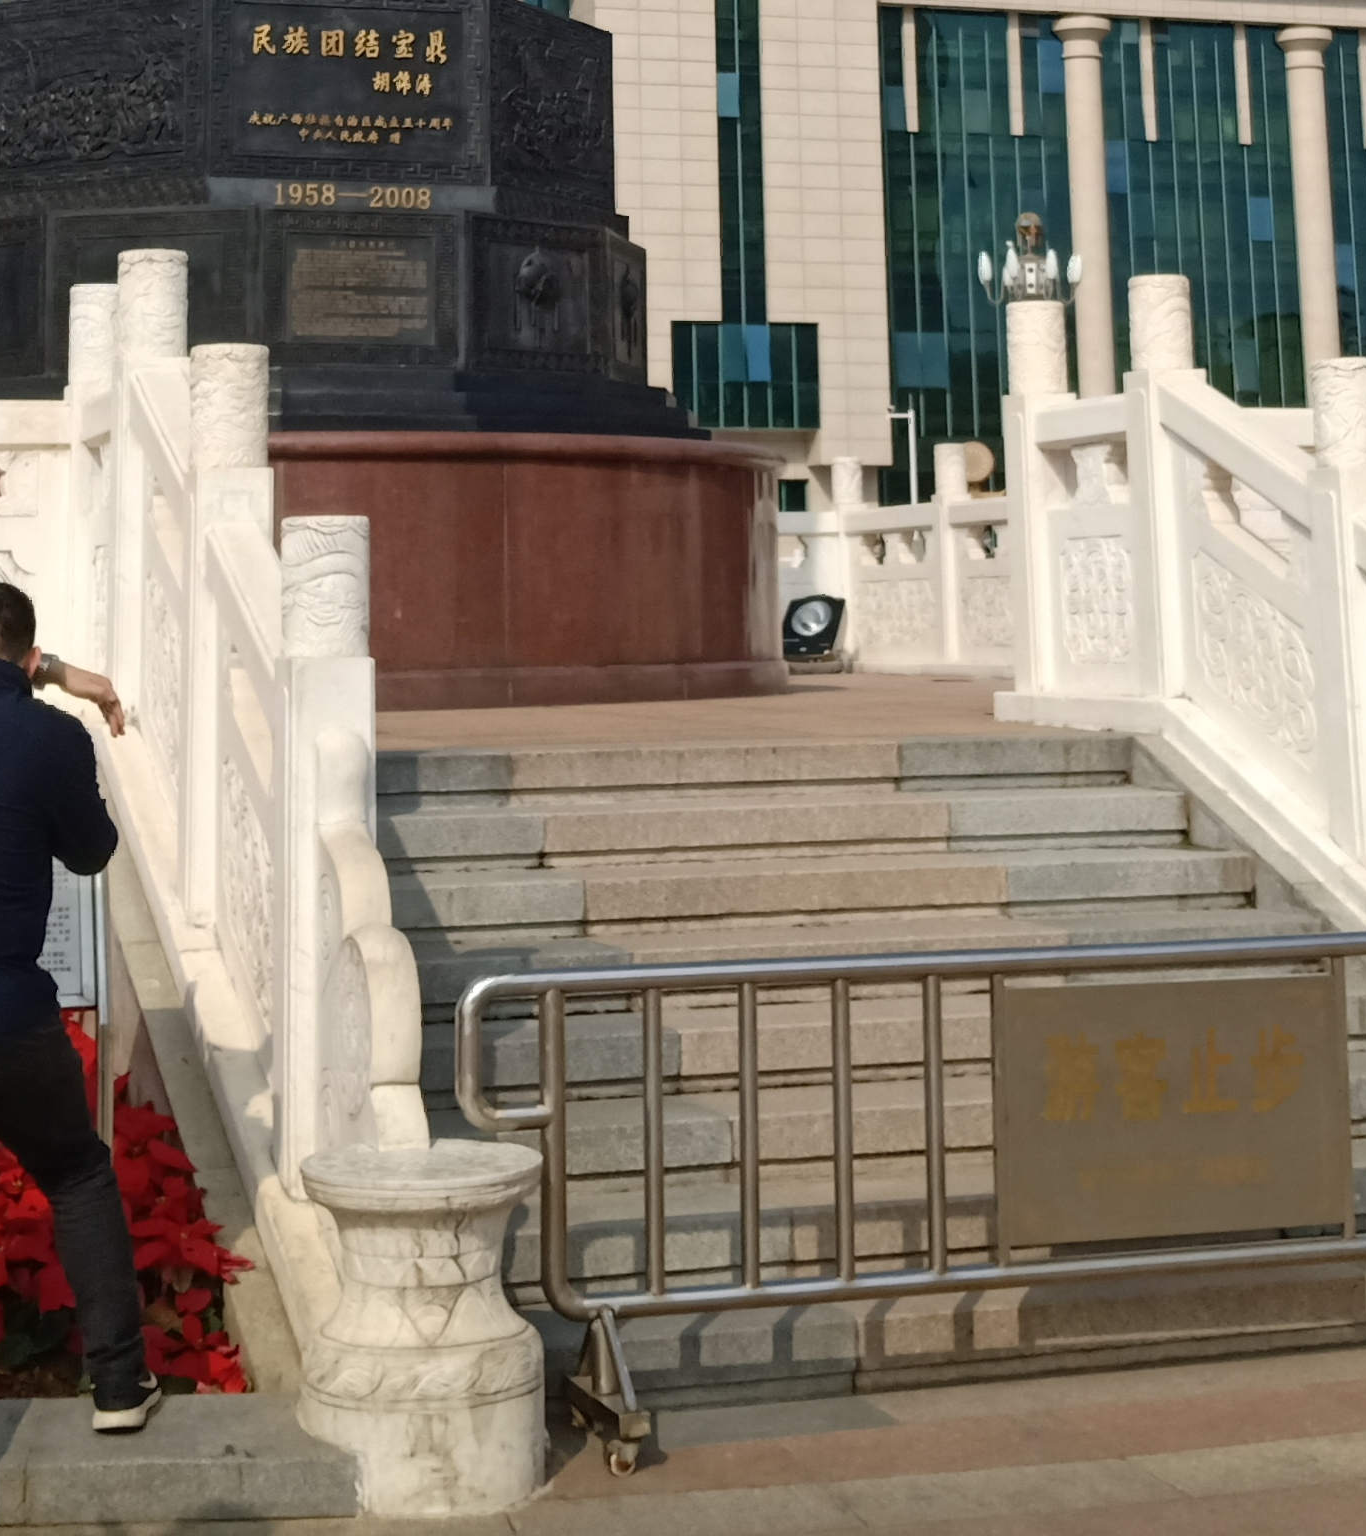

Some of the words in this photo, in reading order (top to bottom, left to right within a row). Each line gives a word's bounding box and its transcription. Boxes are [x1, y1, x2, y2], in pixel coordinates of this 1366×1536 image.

[251, 23, 448, 65] 民族团结宝鼎
